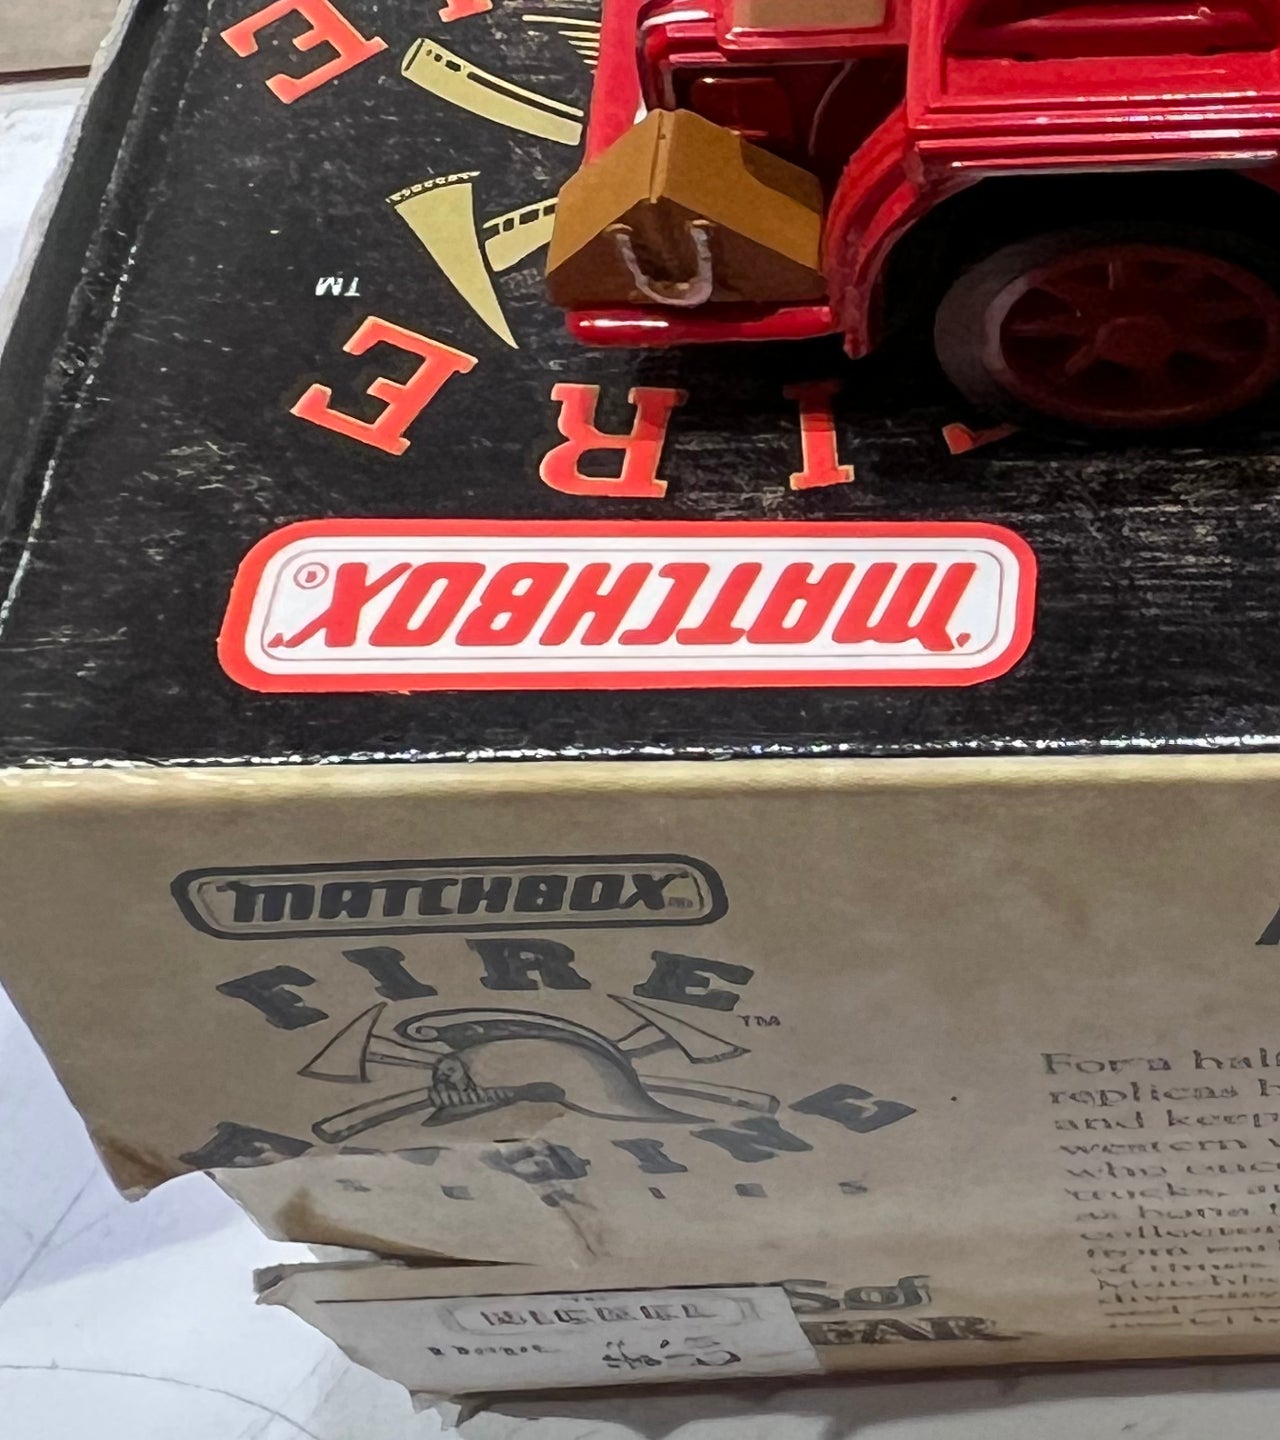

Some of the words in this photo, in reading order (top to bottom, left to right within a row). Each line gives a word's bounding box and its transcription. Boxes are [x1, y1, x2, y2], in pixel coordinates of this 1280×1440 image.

[267, 561, 972, 653] MATCHBOX
[216, 869, 691, 924] MATCHBOX
[215, 937, 755, 1032] FIRE
